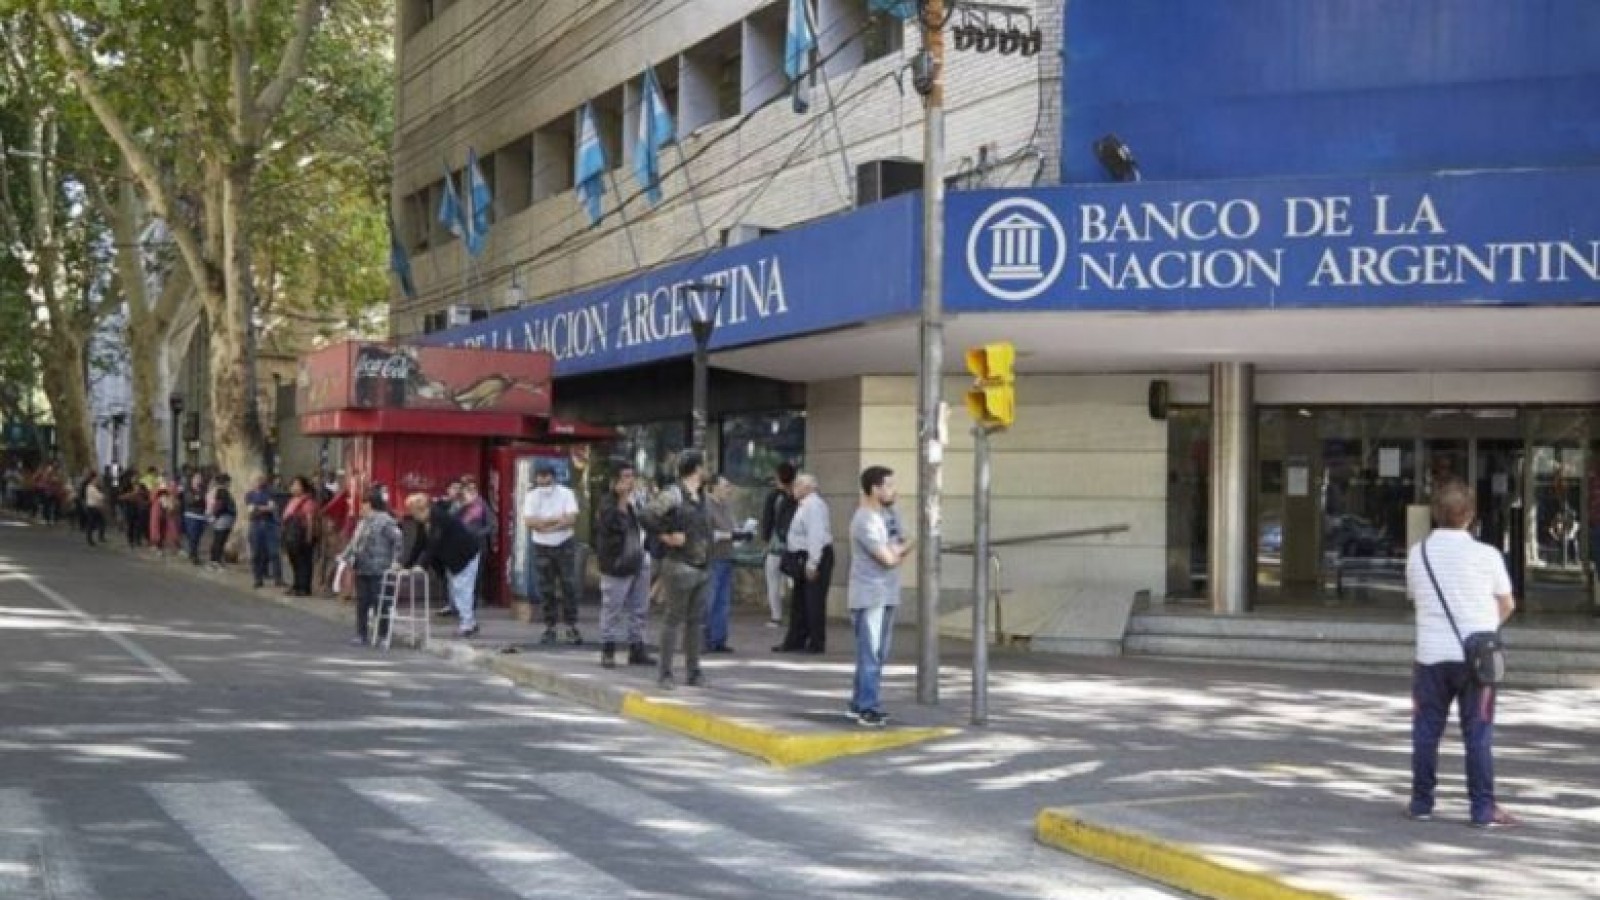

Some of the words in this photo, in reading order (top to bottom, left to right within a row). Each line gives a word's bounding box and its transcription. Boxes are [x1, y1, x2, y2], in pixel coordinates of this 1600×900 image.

[1079, 198, 1260, 243] BANCO
[1283, 195, 1353, 238] DE
[1372, 193, 1447, 236] LA
[1078, 248, 1285, 290] NACION
[524, 302, 610, 361] NACION
[615, 255, 789, 350] ARGENTINA
